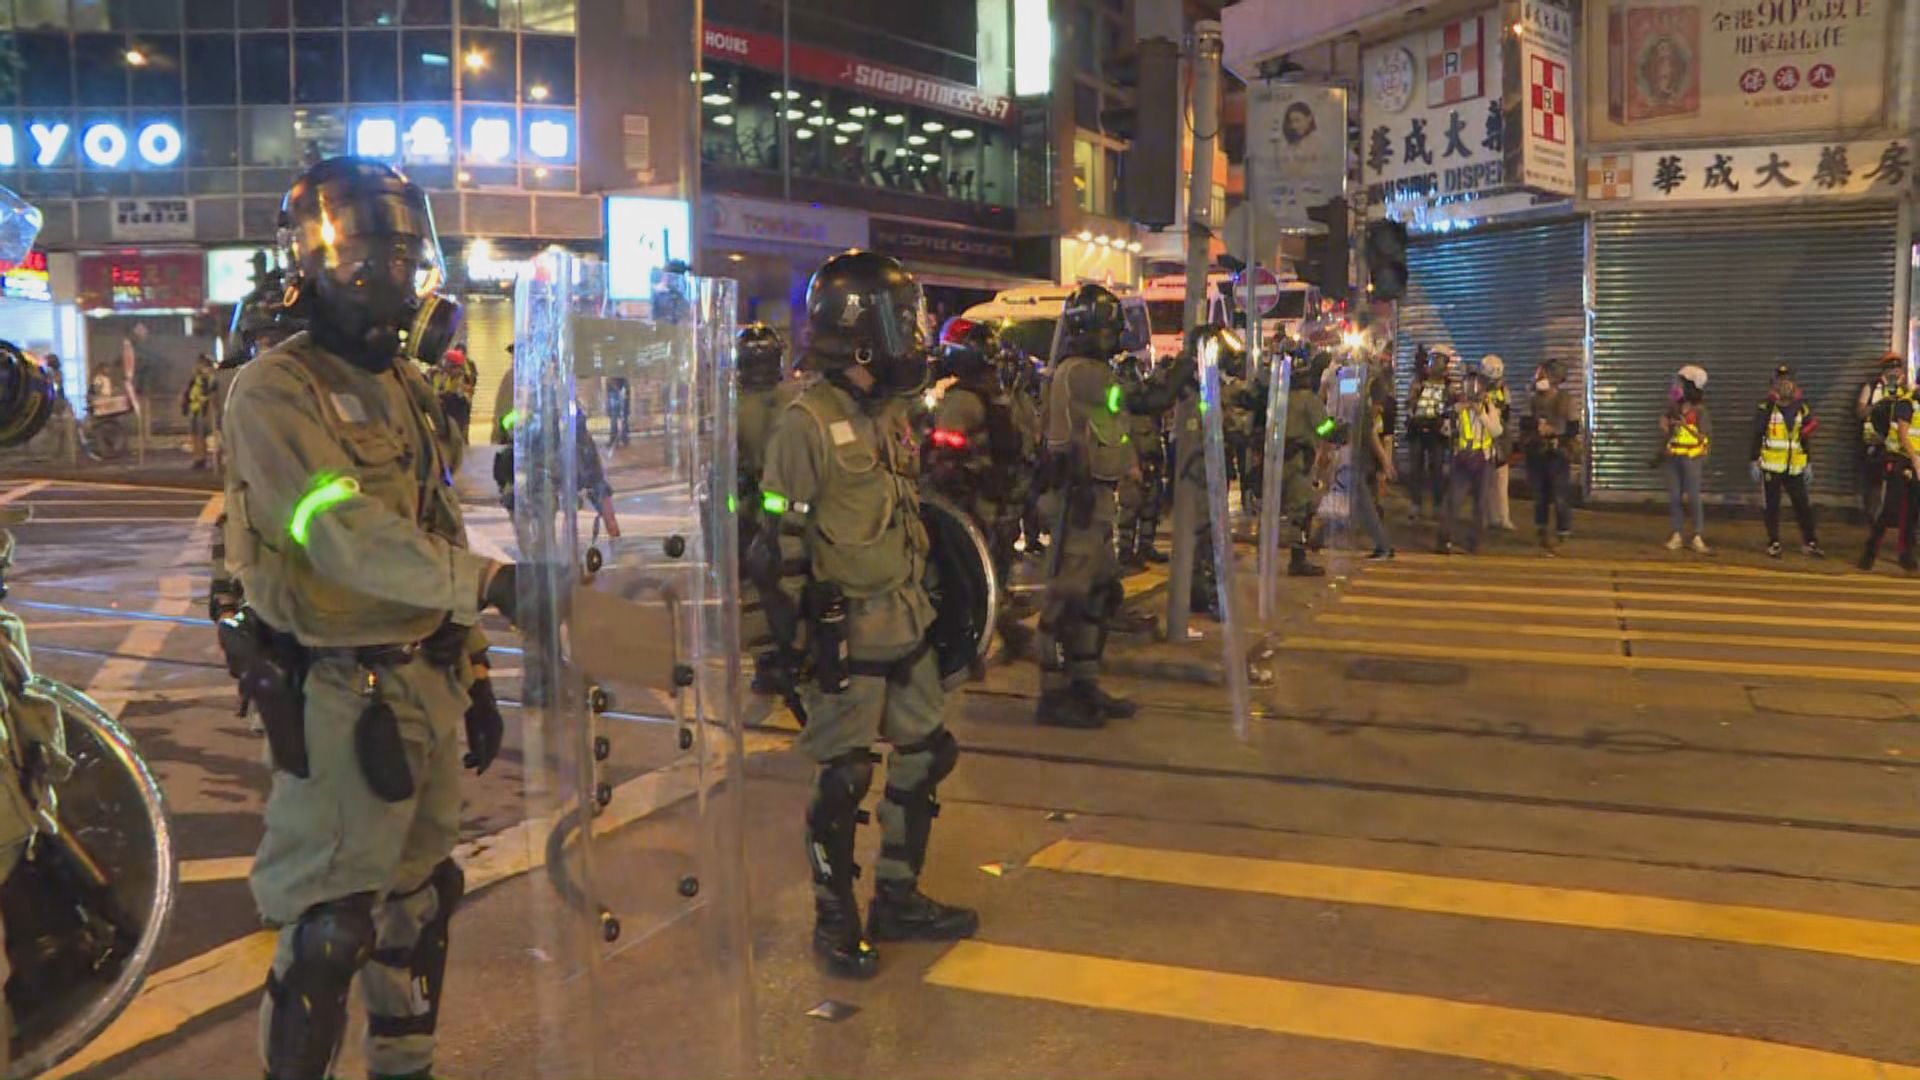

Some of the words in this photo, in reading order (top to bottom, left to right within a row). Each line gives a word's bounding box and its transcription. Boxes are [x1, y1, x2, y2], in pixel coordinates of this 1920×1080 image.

[705, 30, 749, 55] HOURS
[1653, 141, 1910, 195] 華成大藥房
